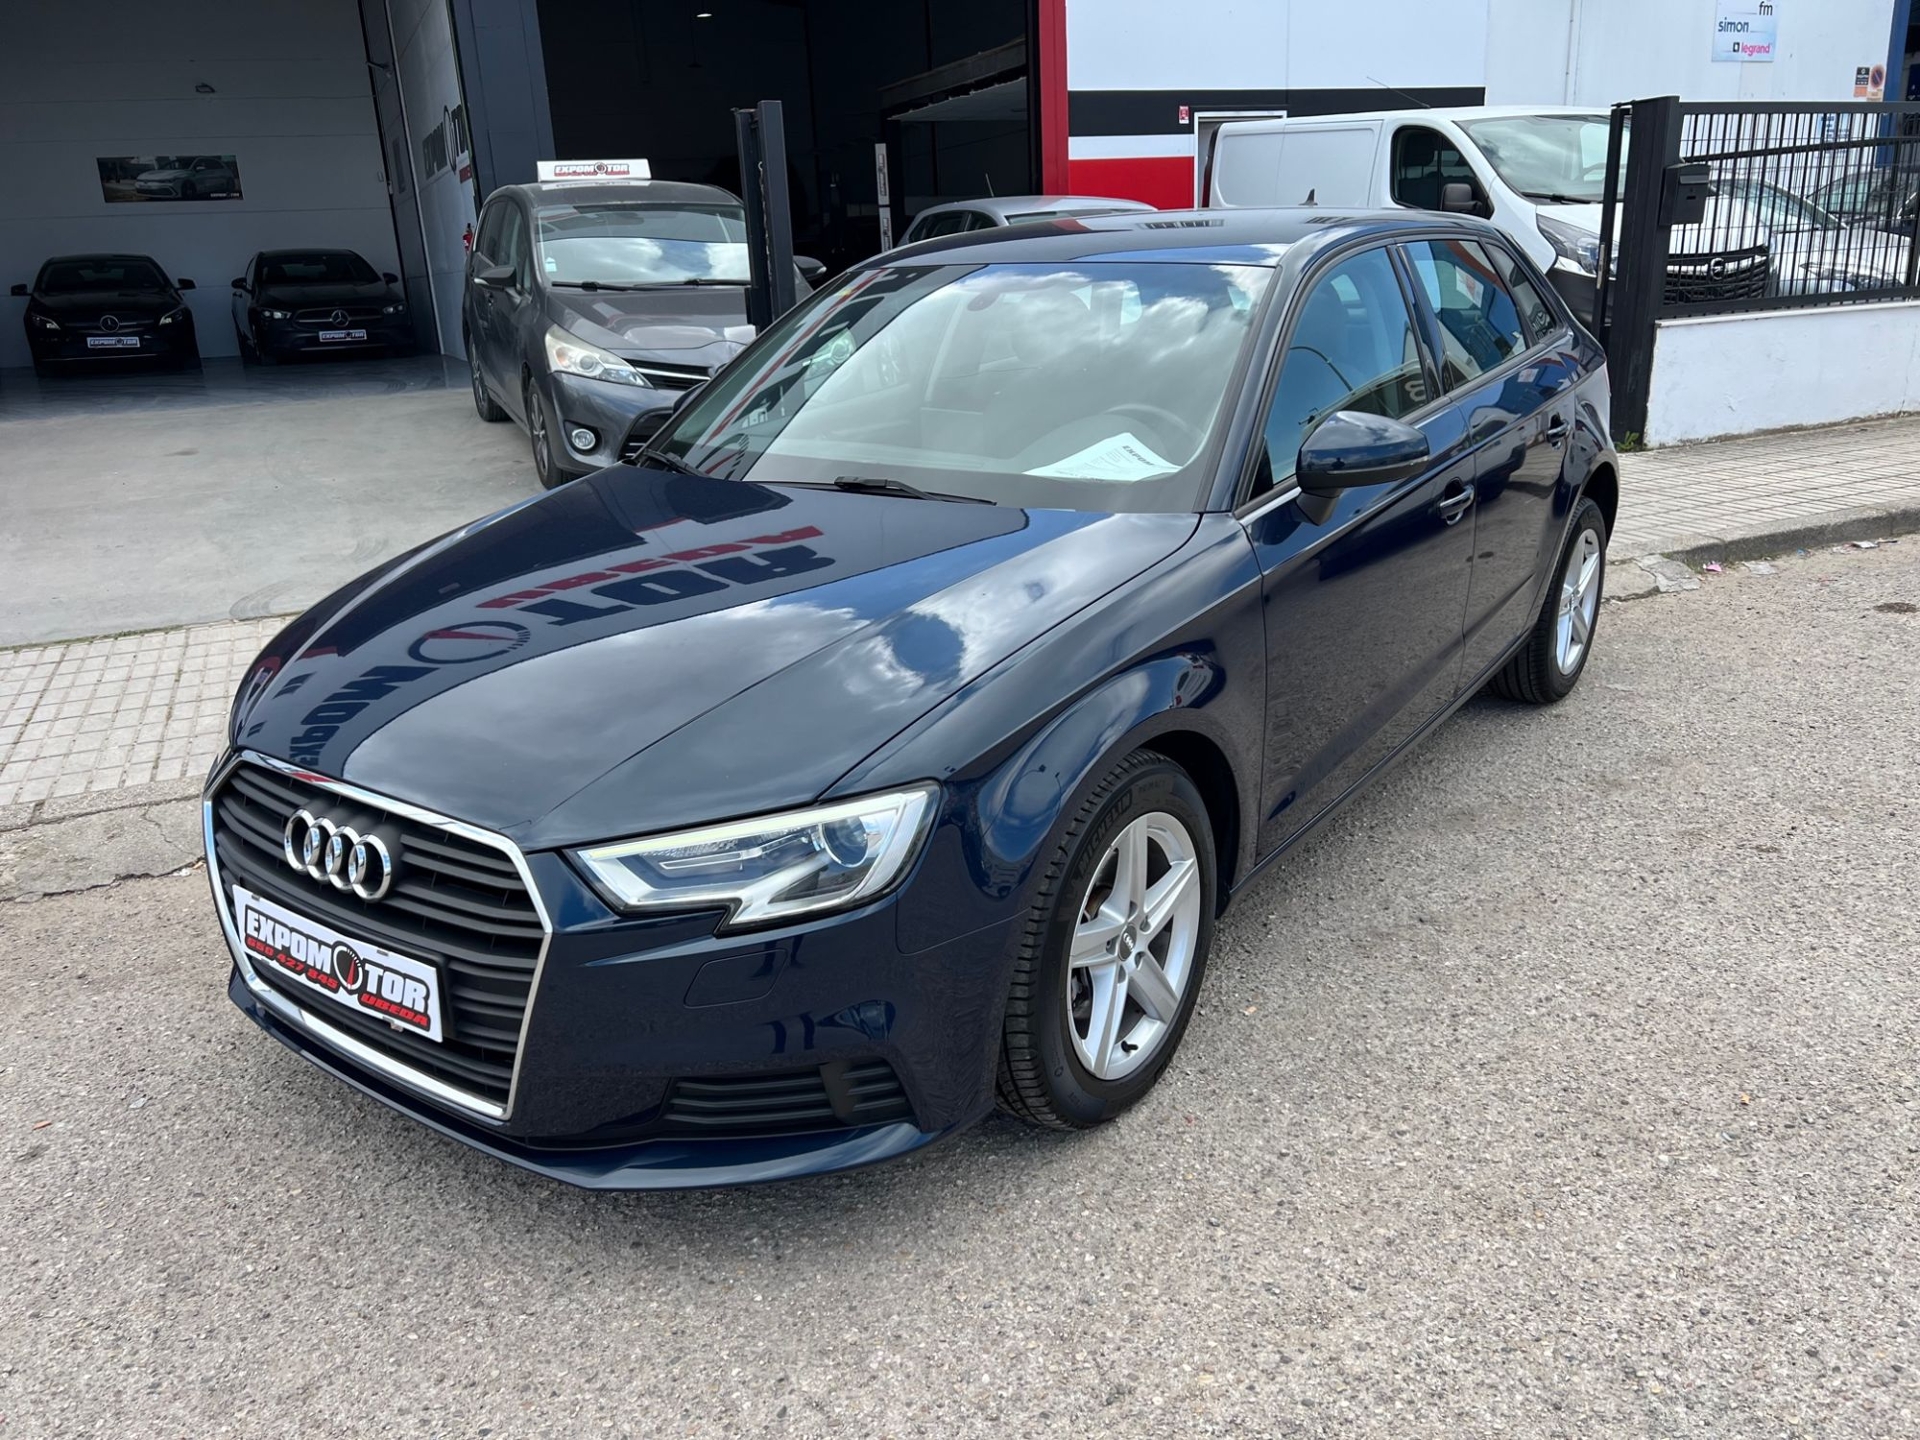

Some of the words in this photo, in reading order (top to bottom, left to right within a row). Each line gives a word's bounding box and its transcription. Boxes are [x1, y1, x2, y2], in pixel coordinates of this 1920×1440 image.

[1758, 1, 1773, 16] fm
[1718, 17, 1749, 33] simon
[1741, 42, 1770, 56] legrand
[1079, 789, 1133, 872] MICHELIN
[277, 952, 304, 971] 427
[360, 993, 429, 1027] UBEDA
